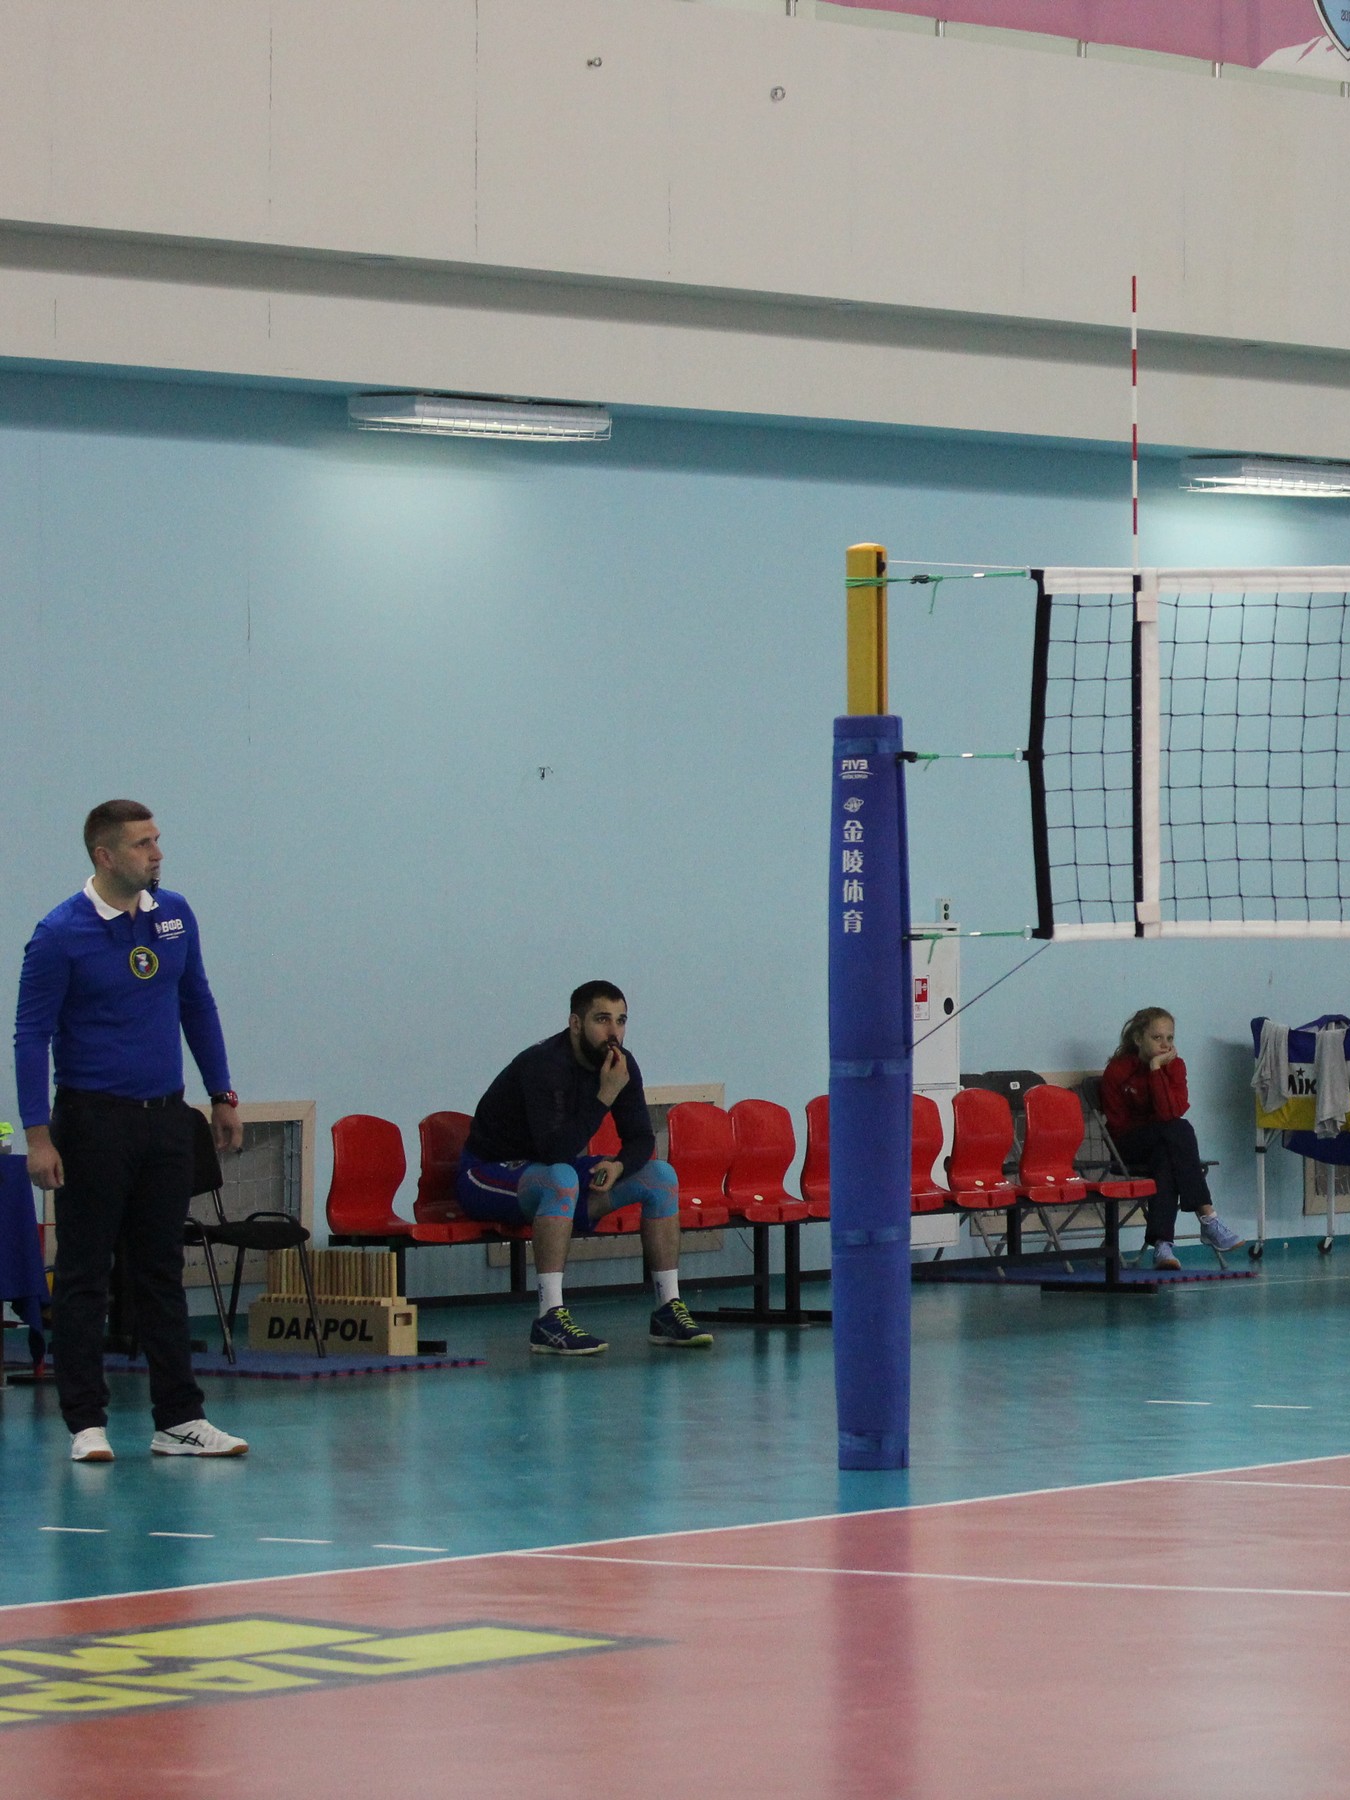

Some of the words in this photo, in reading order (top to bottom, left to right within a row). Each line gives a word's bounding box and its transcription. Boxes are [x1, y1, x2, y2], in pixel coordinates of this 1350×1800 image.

[842, 759, 868, 770] FIVB
[842, 820, 864, 933] 金陵体育
[267, 1316, 374, 1341] DARPOL
